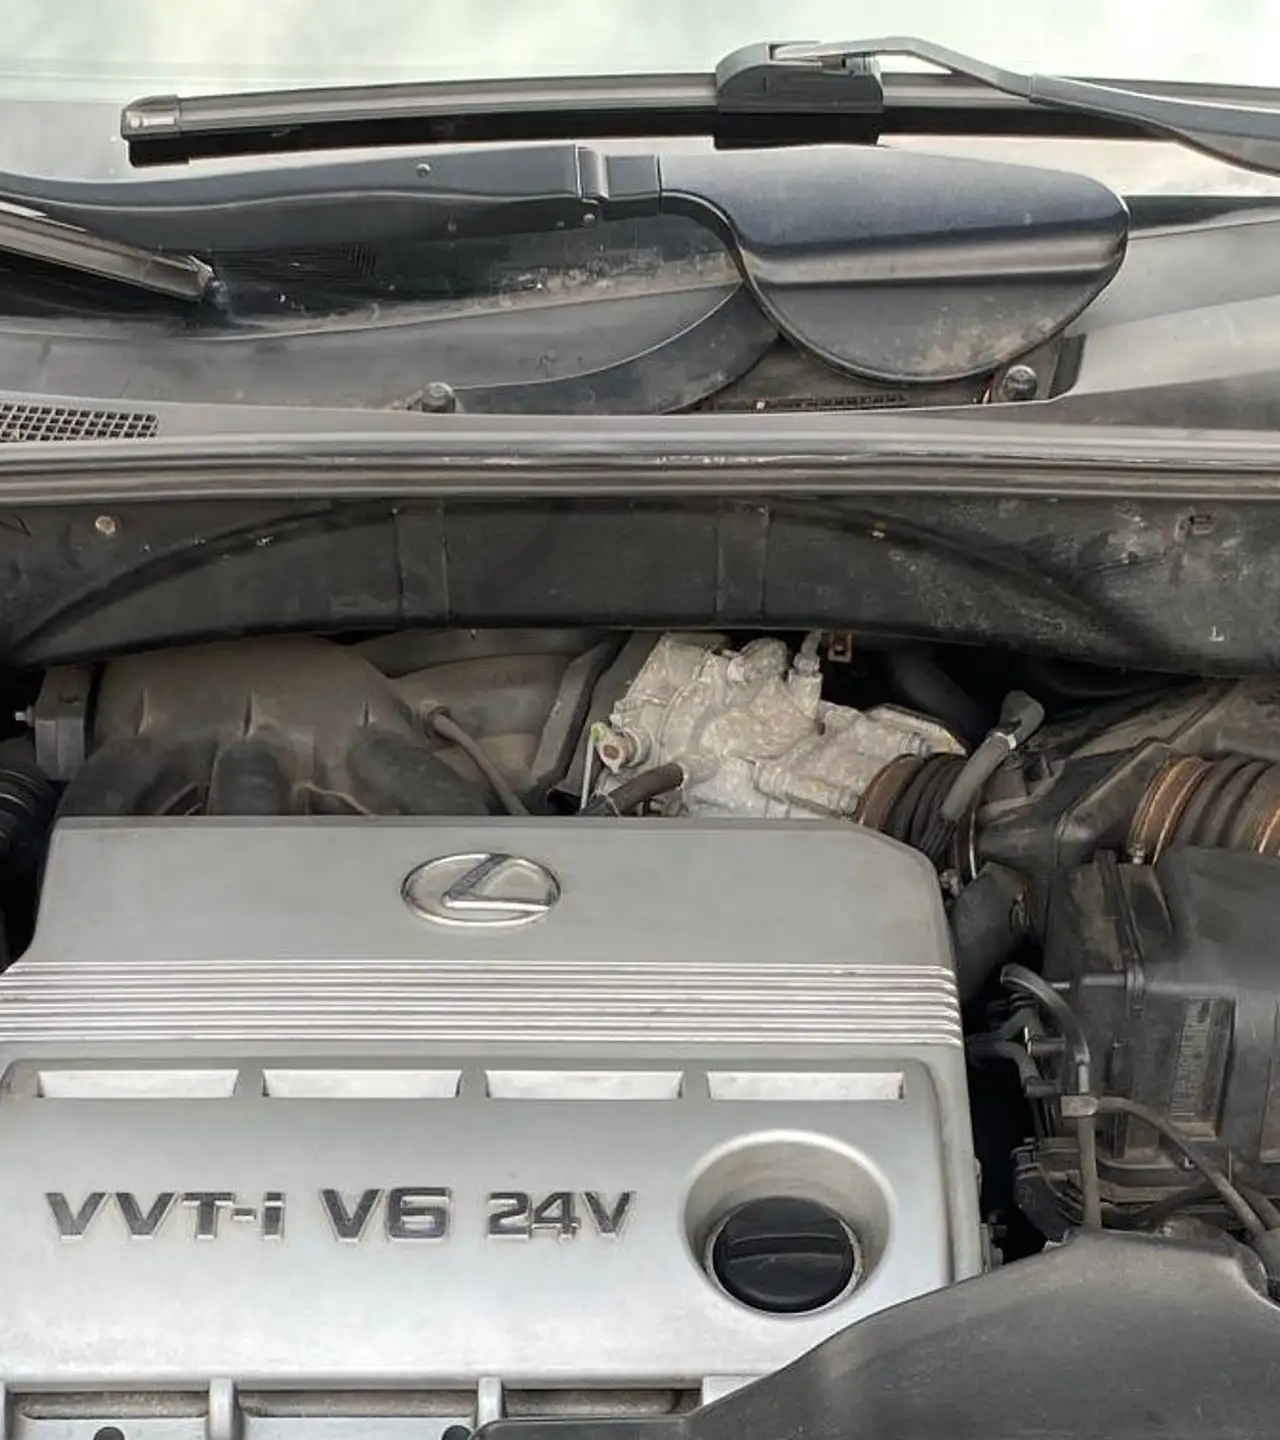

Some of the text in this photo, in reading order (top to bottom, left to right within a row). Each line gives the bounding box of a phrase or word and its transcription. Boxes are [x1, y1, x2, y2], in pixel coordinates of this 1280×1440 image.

[44, 1186, 637, 1244] VVT-i V6 24V
